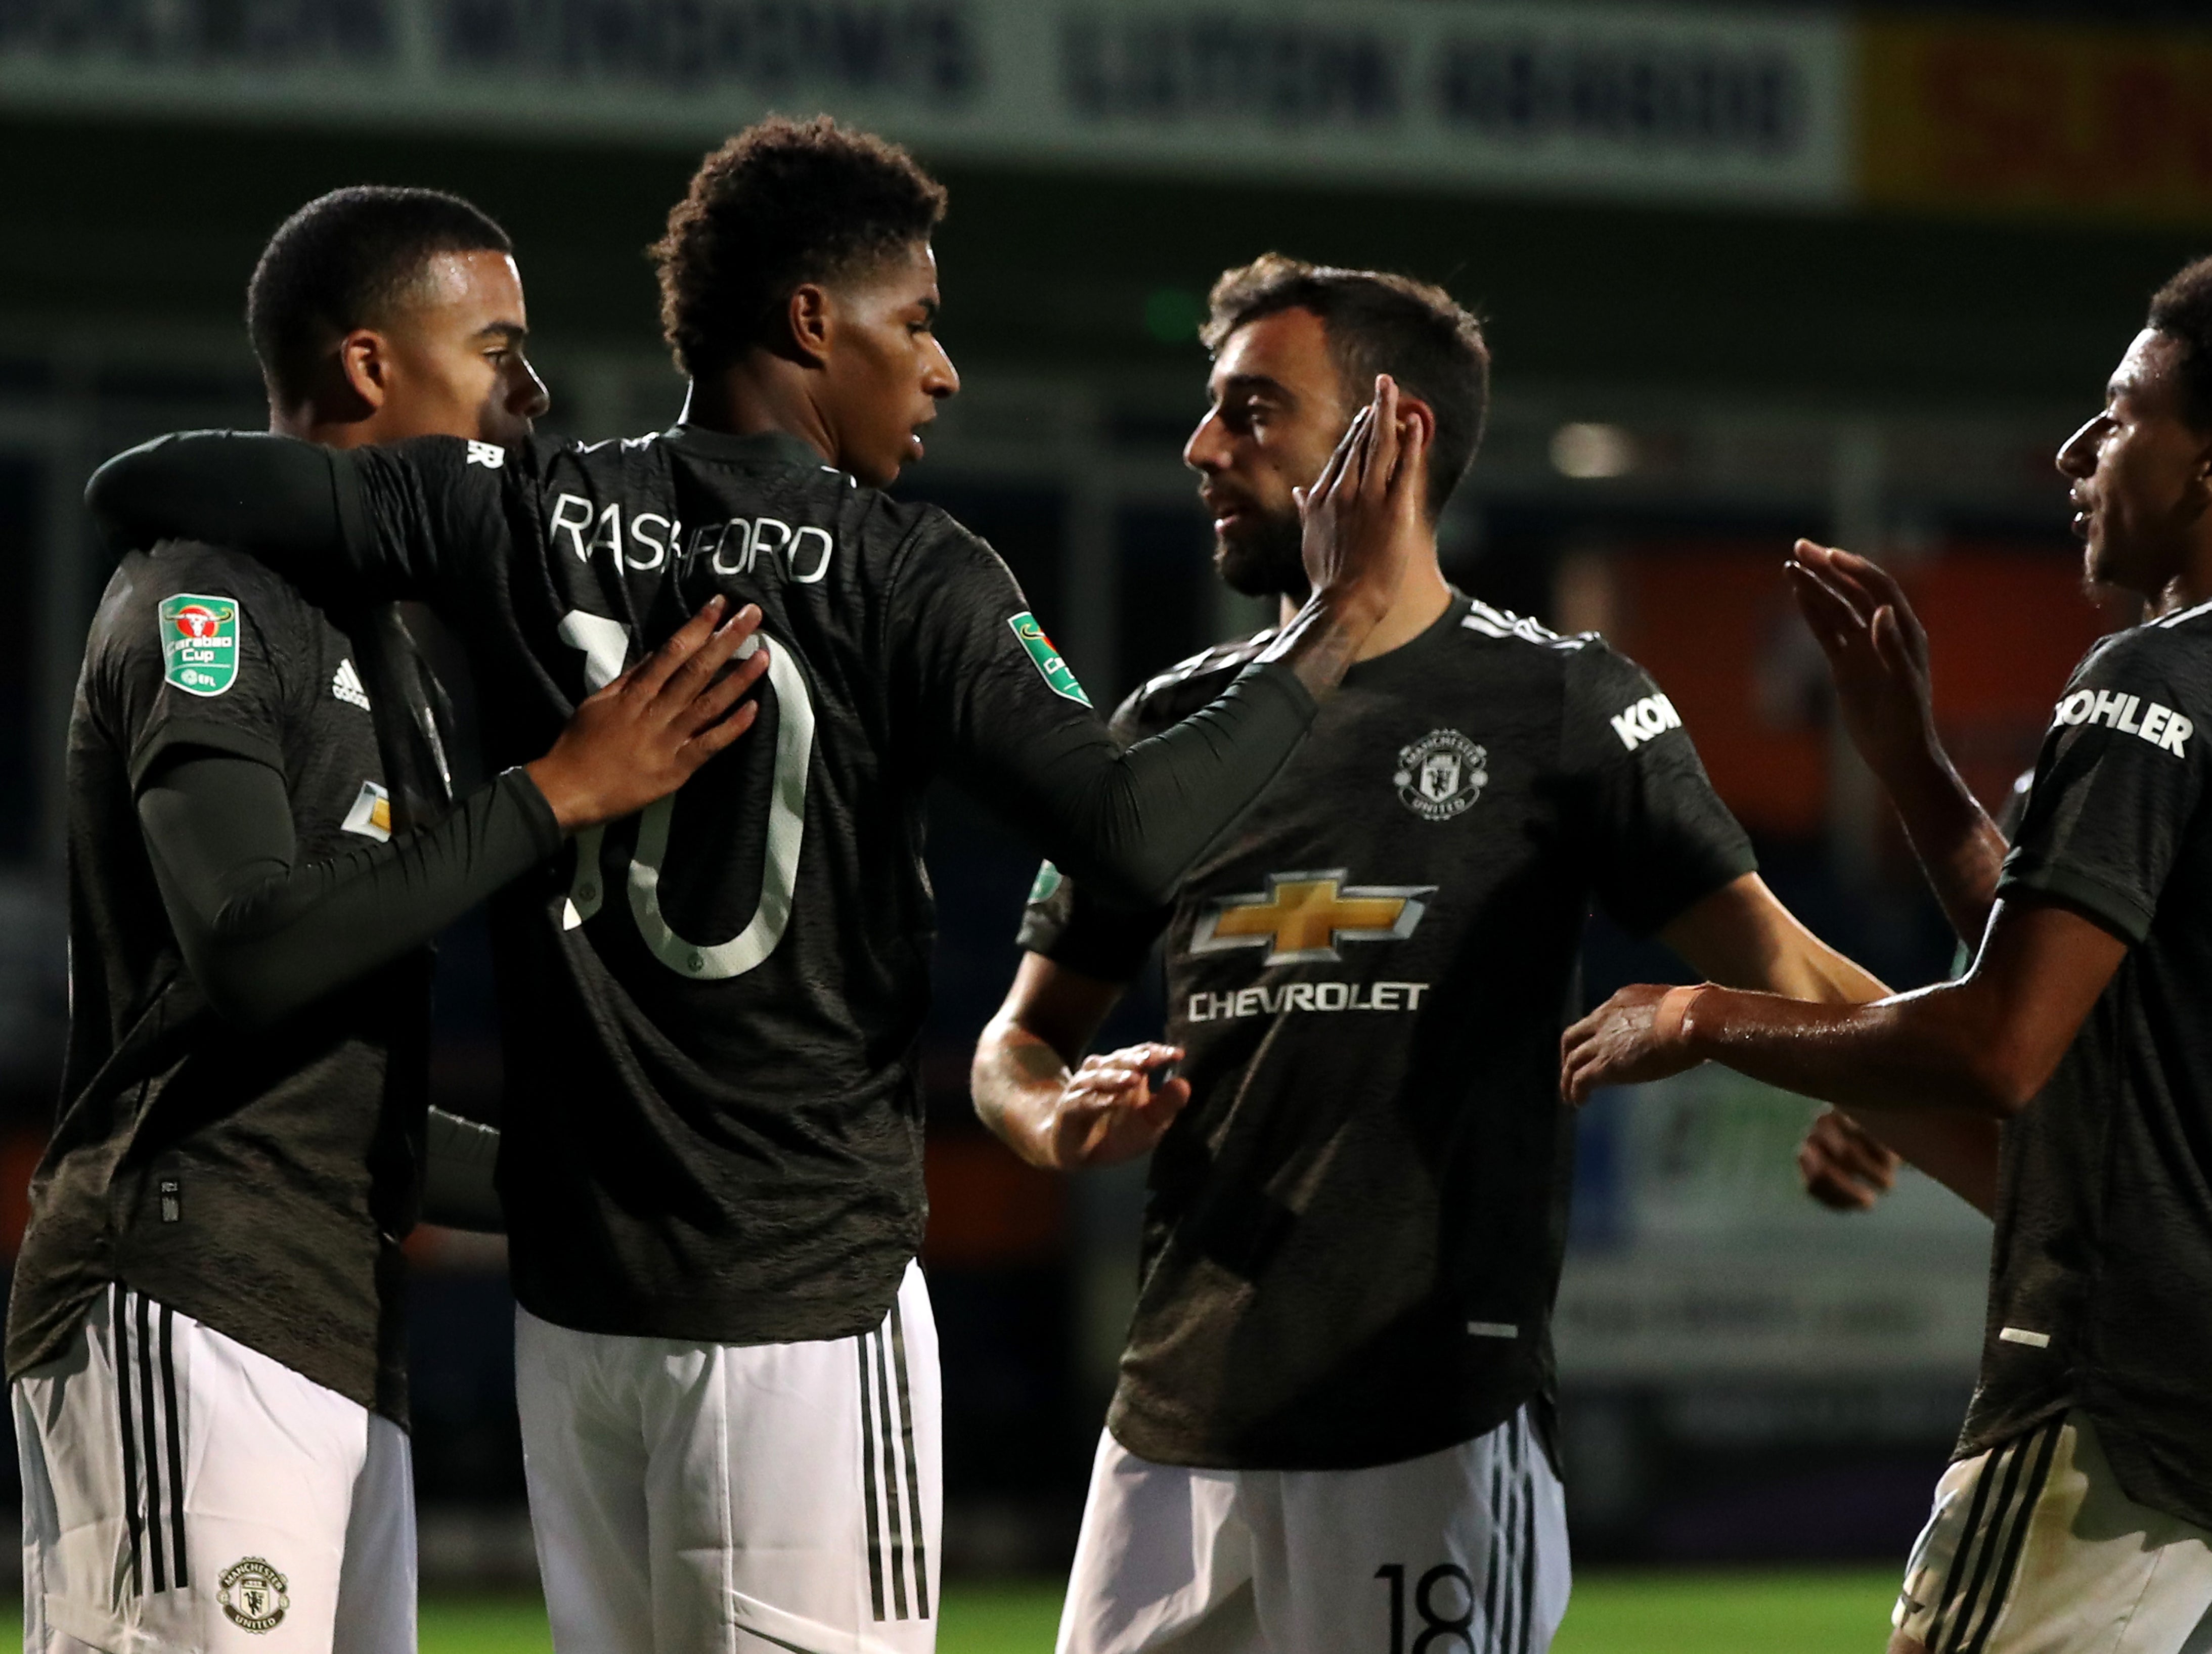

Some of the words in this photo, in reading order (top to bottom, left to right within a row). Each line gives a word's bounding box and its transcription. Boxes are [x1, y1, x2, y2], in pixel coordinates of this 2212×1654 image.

[181, 647, 215, 663] Cup
[1188, 980, 1431, 1022] CHEVROLET
[224, 1562, 283, 1592] MANCHESTER
[234, 1614, 277, 1629] UNITED
[1374, 1563, 1476, 1654] 18
